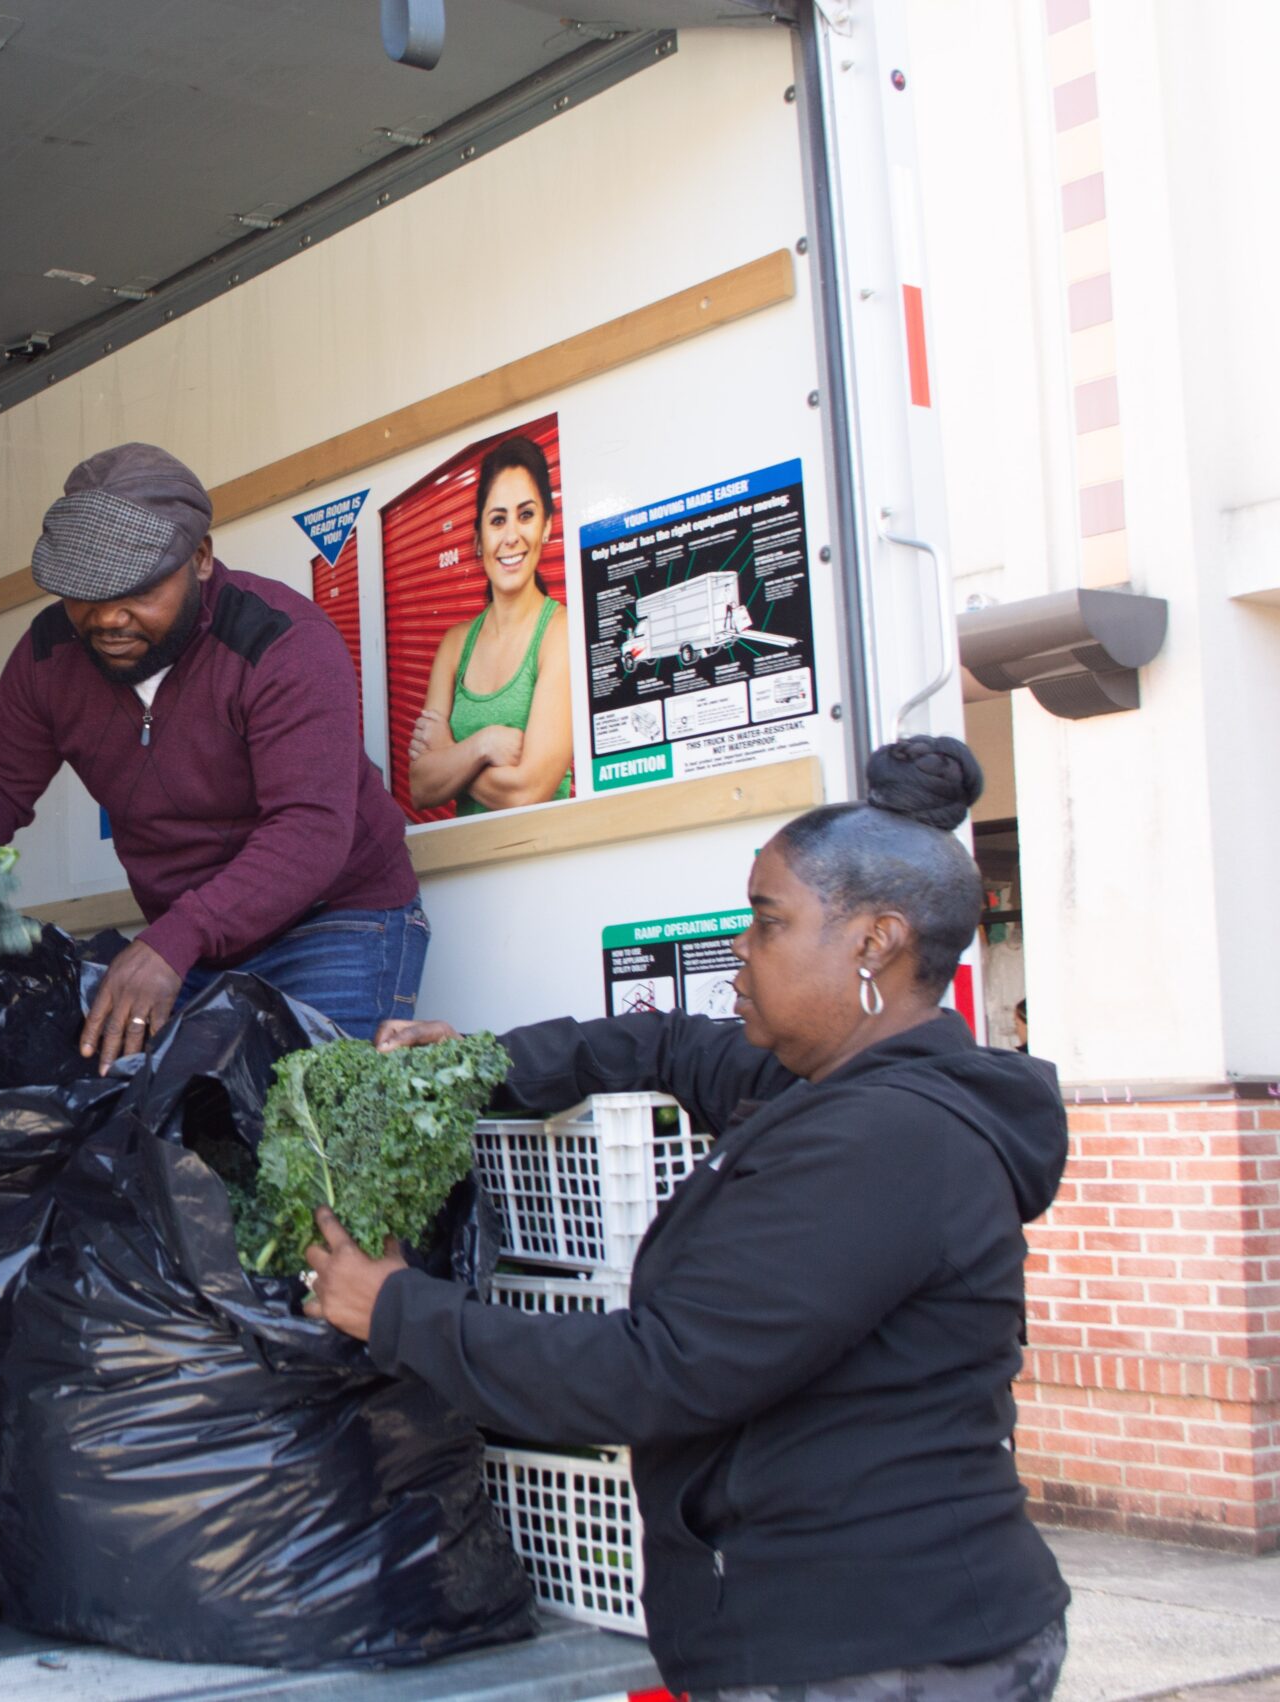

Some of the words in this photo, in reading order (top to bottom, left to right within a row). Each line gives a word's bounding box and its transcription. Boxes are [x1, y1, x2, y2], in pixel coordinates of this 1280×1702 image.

[304, 509, 324, 526] YOUR
[326, 499, 350, 518] ROOM
[352, 496, 361, 509] IS
[624, 511, 648, 528] YOUR
[649, 499, 685, 521] MOVING
[686, 490, 713, 510] MADE
[310, 517, 336, 537] READY
[338, 512, 355, 528] FOR
[592, 547, 609, 561] Only
[640, 535, 655, 547] has
[656, 530, 670, 542] the
[671, 522, 692, 538] right
[693, 508, 738, 531] equipment
[739, 505, 752, 517] for
[323, 529, 342, 546] YOU!
[439, 548, 459, 568] 2304
[686, 742, 700, 750] THIS
[704, 737, 725, 747] TRUCK
[727, 734, 734, 742] IS
[713, 745, 726, 754] NOT
[599, 754, 666, 782] ATTENTION
[634, 926, 662, 940] RAMP
[664, 918, 718, 937] OPERATING
